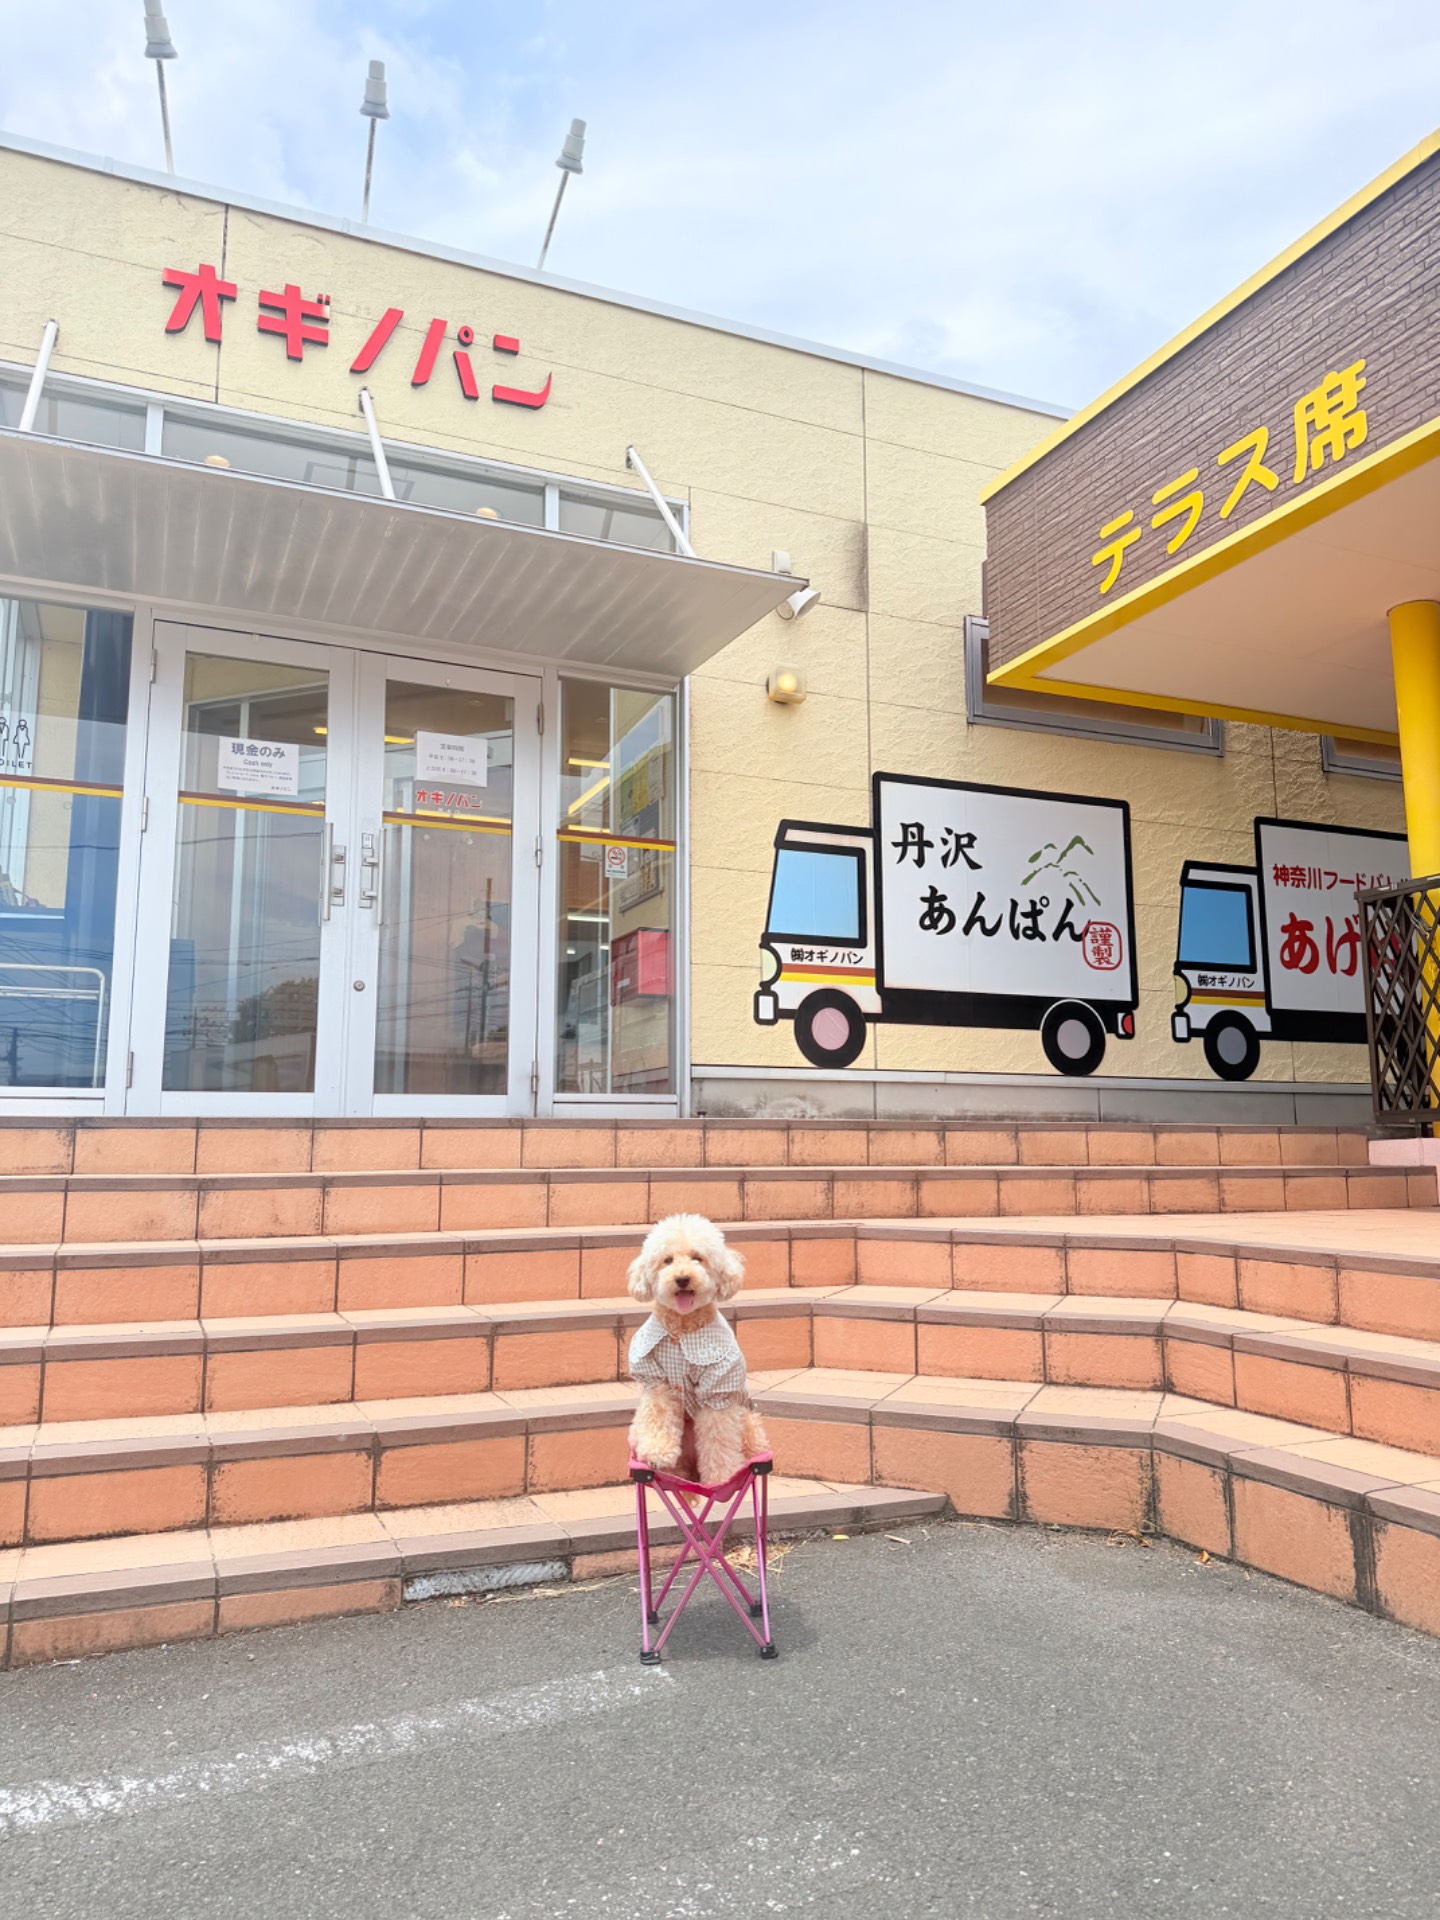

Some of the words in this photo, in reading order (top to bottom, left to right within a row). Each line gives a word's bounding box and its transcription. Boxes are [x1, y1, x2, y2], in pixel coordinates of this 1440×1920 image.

[162, 263, 552, 409] オギノパン
[1091, 358, 1367, 595] テラス席
[231, 742, 286, 759] 現金のみ
[891, 821, 983, 871] 丹沢
[918, 884, 1091, 943] あんぱん
